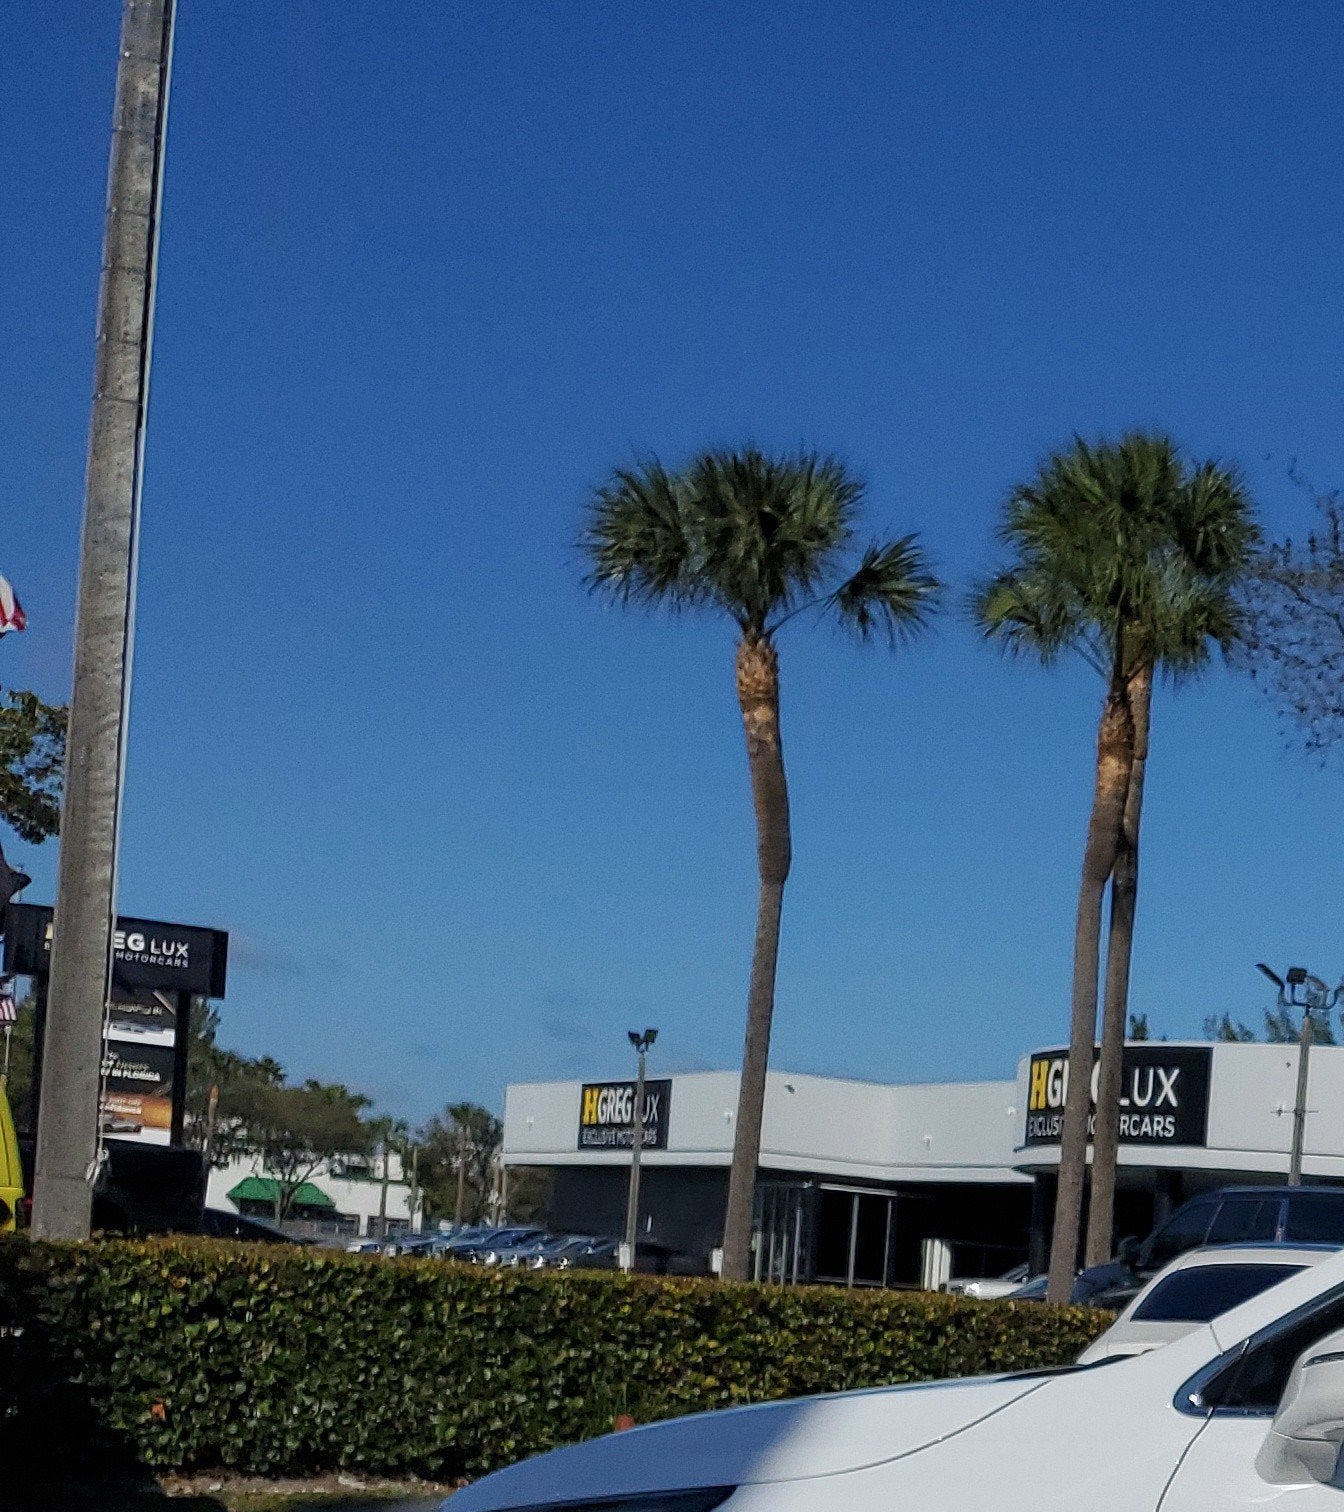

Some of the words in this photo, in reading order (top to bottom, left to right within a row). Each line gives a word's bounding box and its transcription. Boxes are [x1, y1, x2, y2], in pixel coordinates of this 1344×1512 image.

[150, 938, 189, 958] LUX
[582, 1086, 633, 1125] HGREG
[1119, 1067, 1180, 1107] UX
